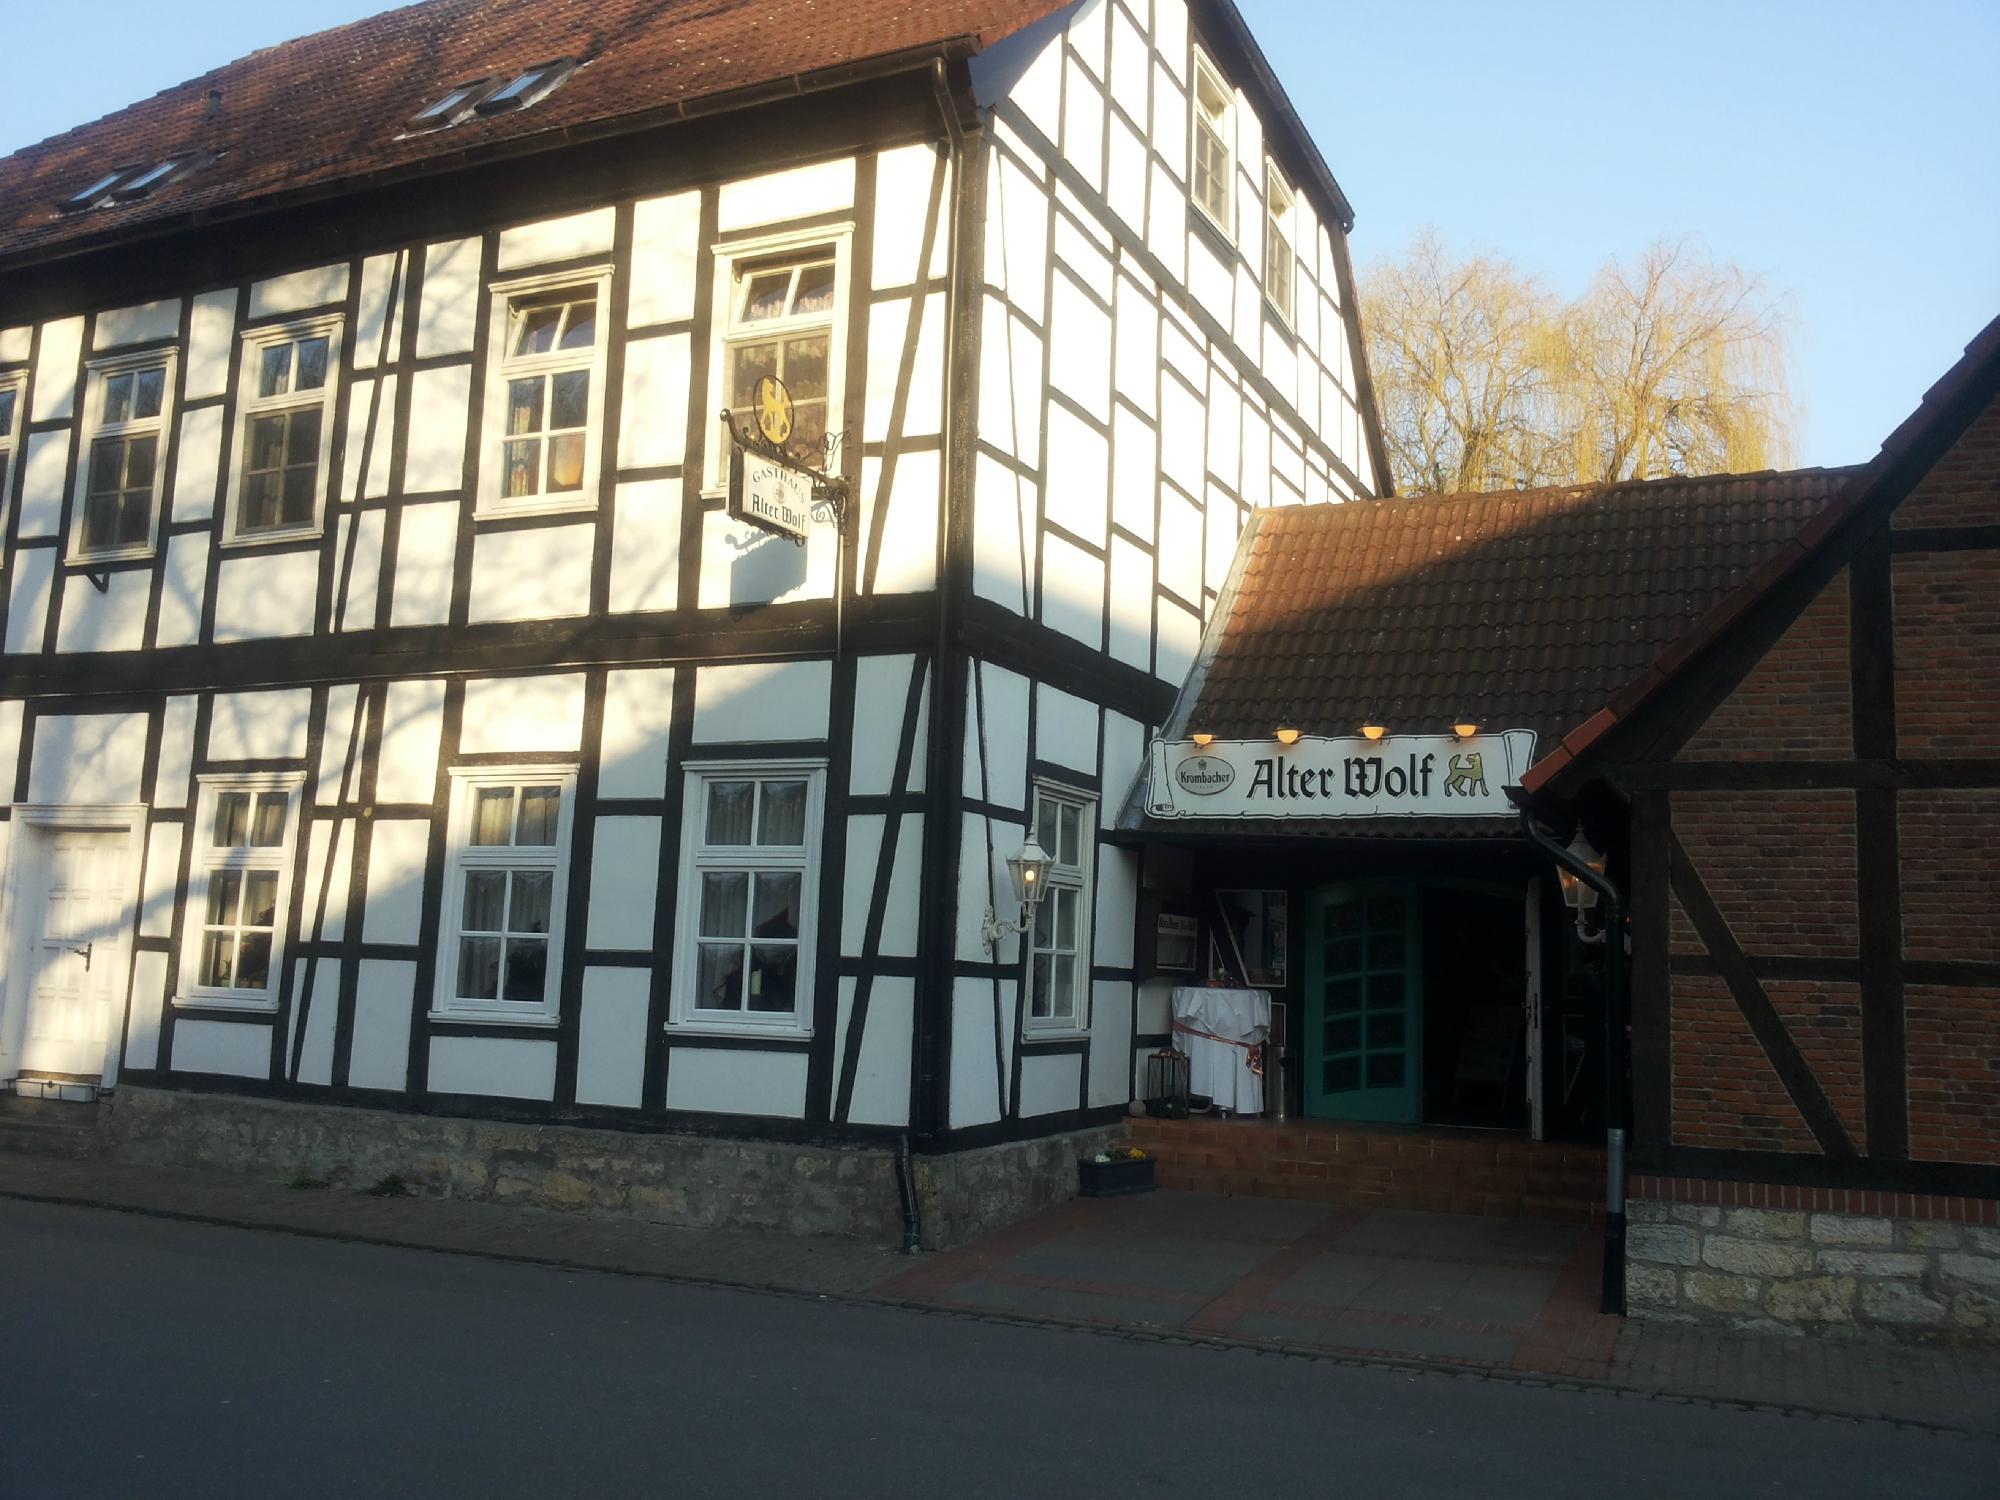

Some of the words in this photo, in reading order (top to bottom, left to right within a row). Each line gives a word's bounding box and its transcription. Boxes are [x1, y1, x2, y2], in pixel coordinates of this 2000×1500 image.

[752, 466, 807, 504] GASTHAUS
[752, 493, 779, 519] Alter
[781, 505, 807, 533] Wolf
[1180, 771, 1231, 784] Krombacher
[1246, 755, 1335, 799] Alter
[1343, 752, 1436, 799] Wolf
